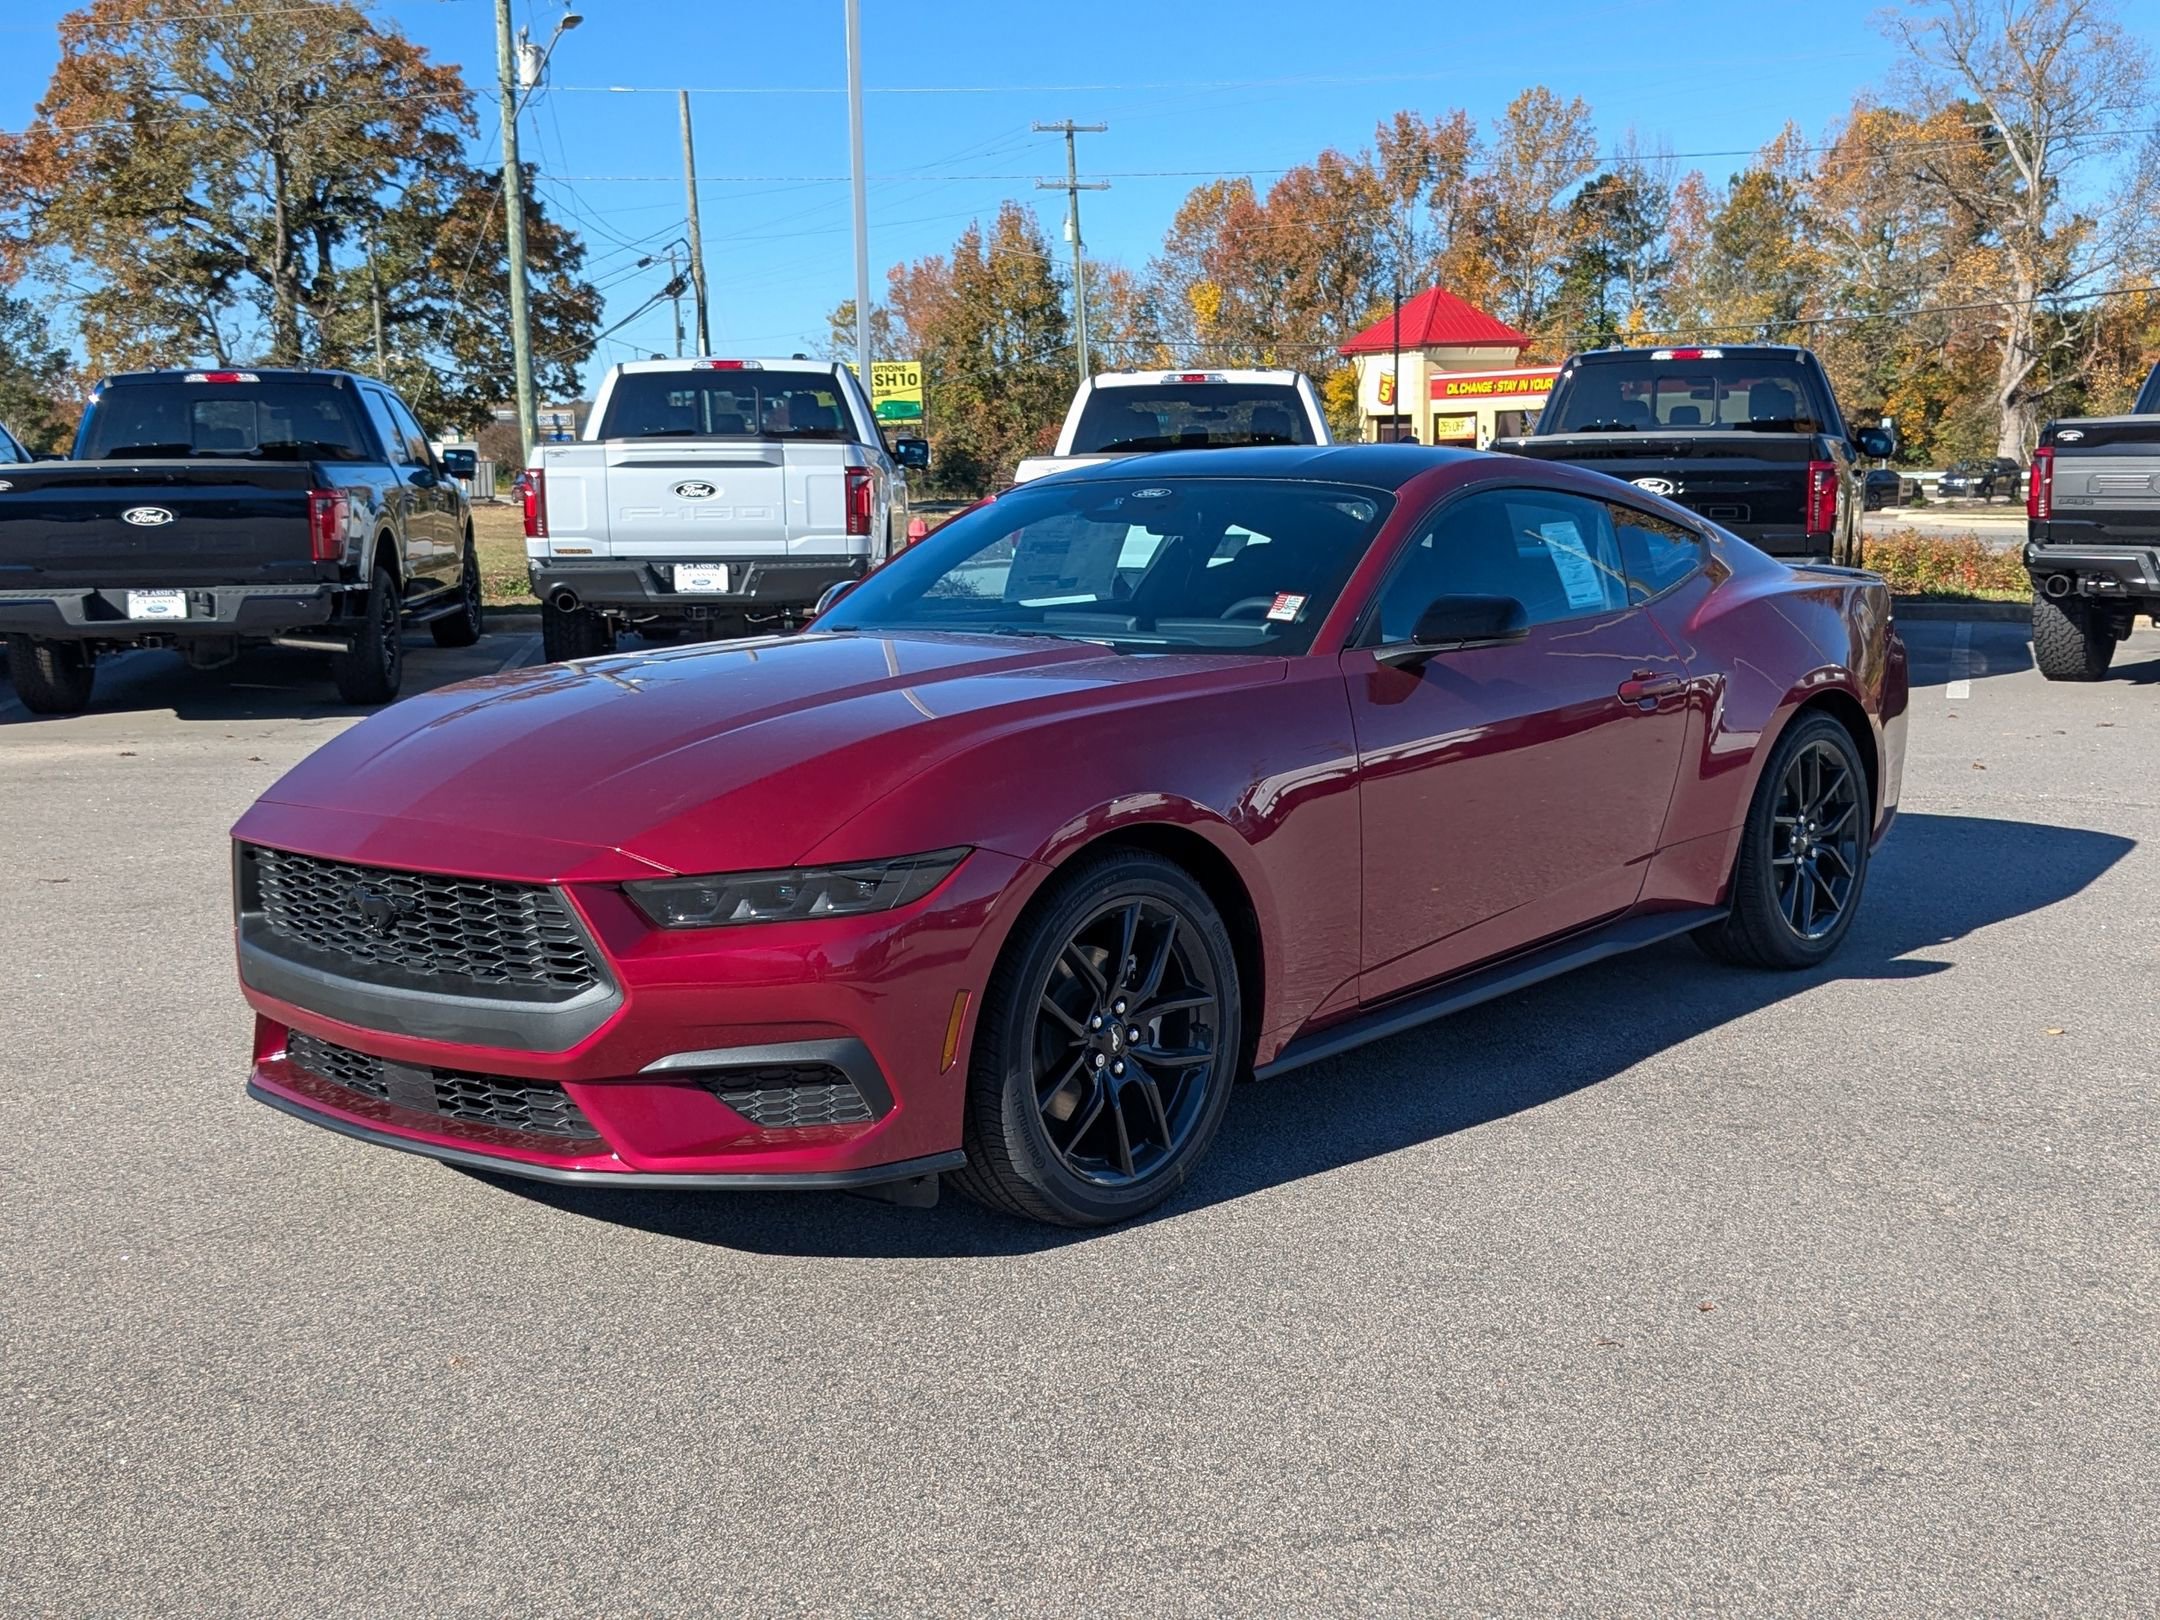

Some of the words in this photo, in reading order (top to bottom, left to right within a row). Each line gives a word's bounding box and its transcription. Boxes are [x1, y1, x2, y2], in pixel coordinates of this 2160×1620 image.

[1379, 383, 1390, 402] 5
[1447, 383, 1458, 395] OIL
[1459, 380, 1493, 394] CHANGE
[1496, 379, 1518, 392] STAY
[1518, 379, 1529, 391] IN
[1530, 377, 1553, 391] YOUR
[1453, 420, 1465, 431] OFF
[680, 483, 712, 497] Ford
[132, 510, 164, 523] Ford
[620, 506, 775, 520] F-150
[1014, 1100, 1046, 1169] Continental
